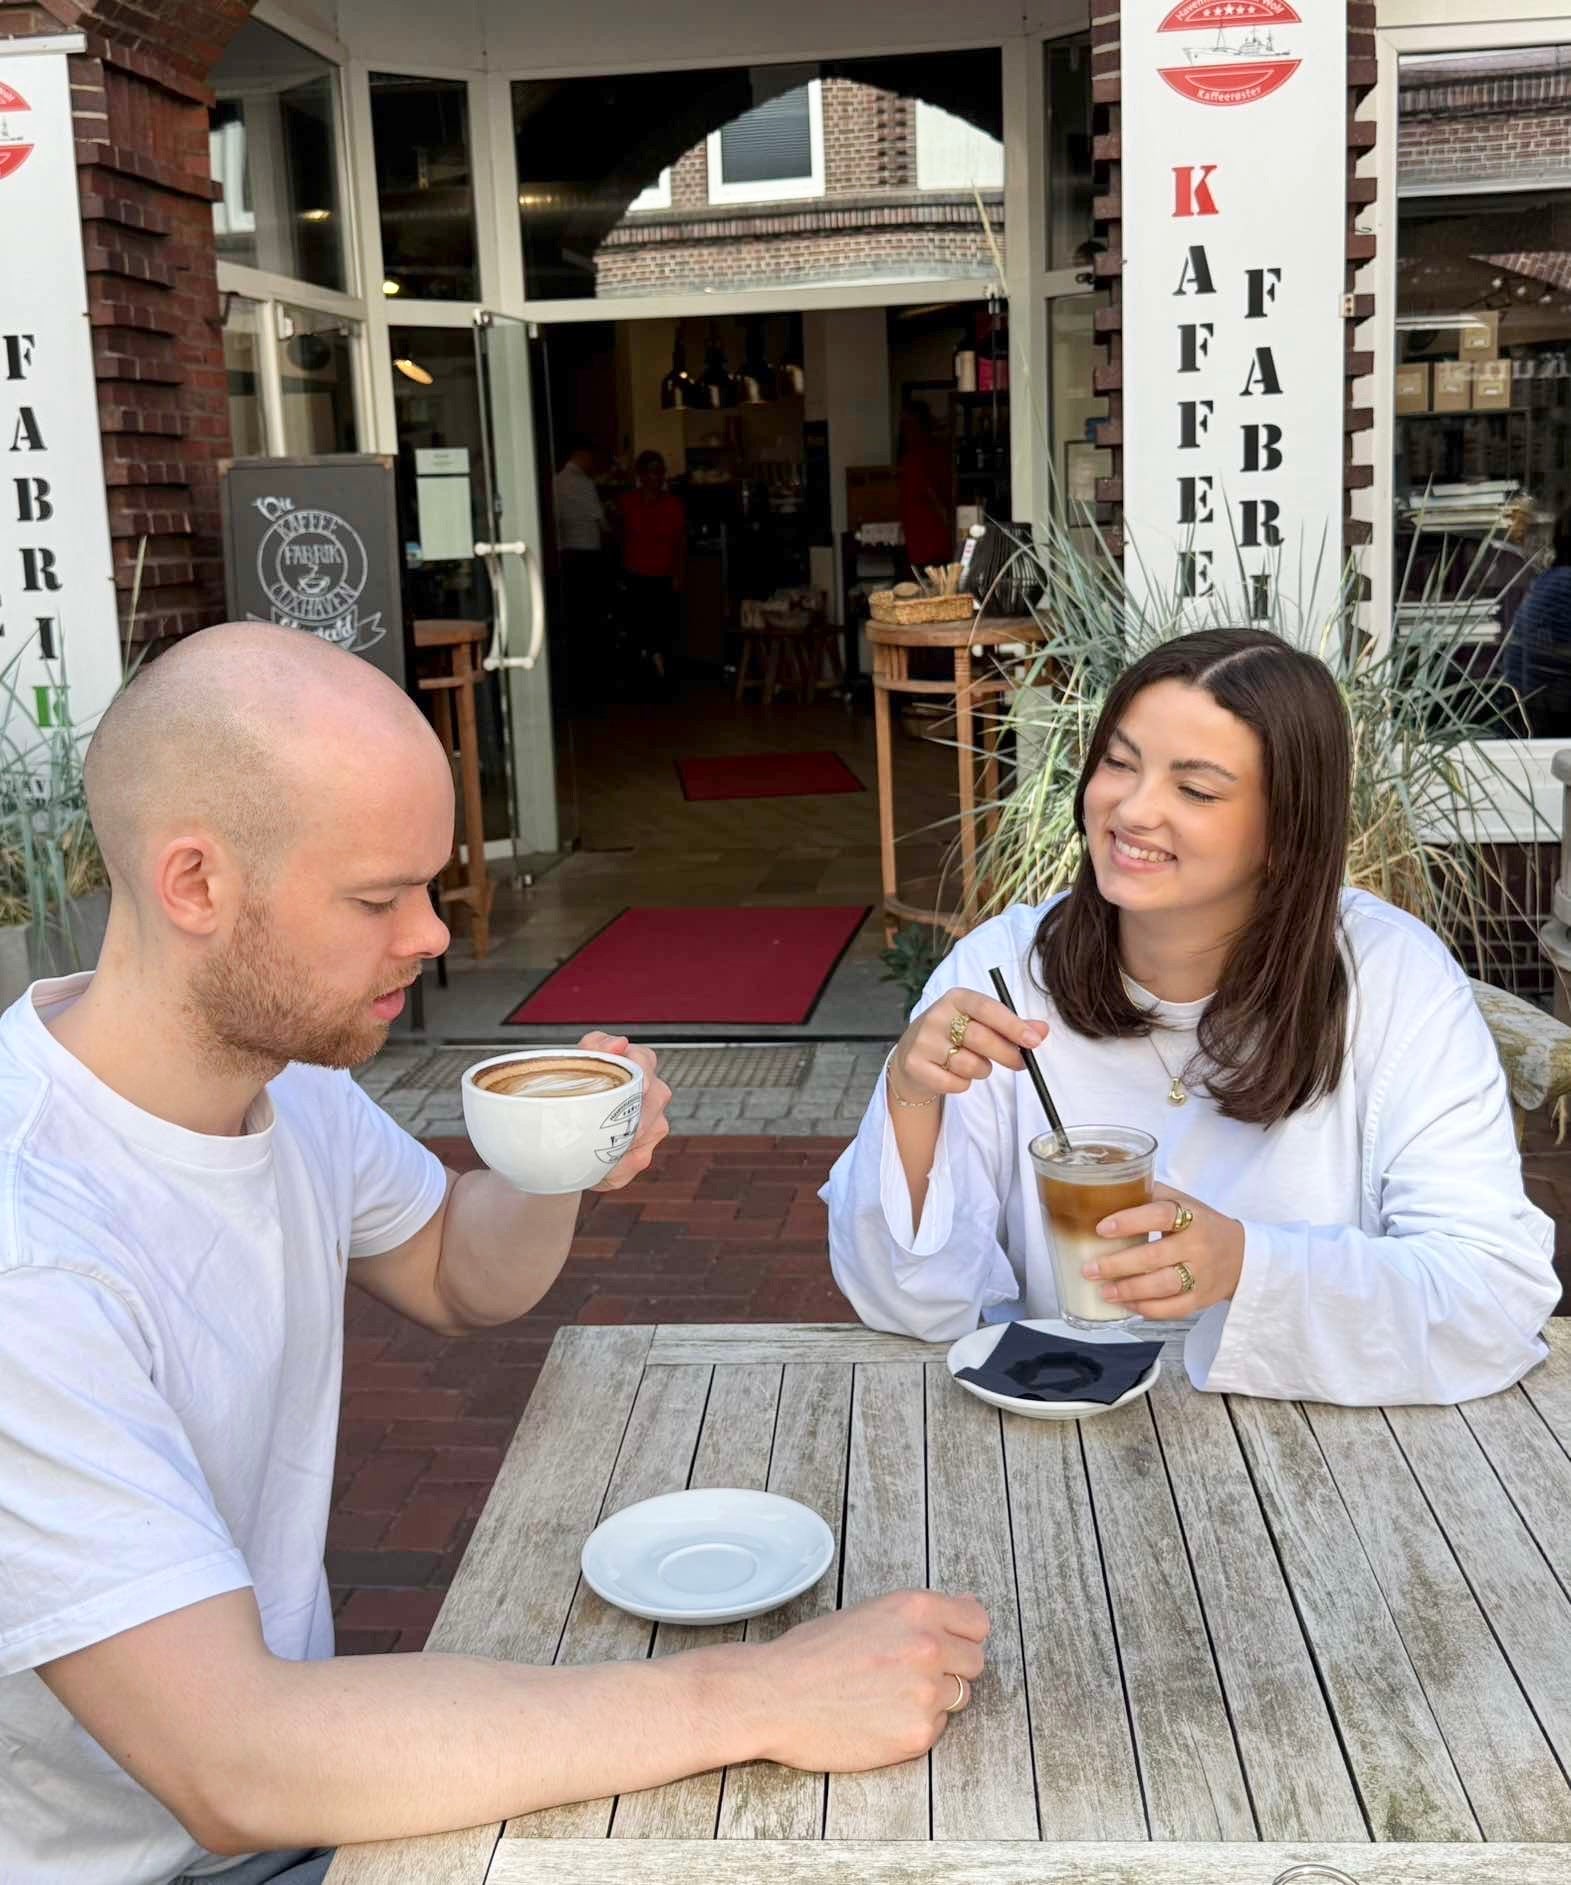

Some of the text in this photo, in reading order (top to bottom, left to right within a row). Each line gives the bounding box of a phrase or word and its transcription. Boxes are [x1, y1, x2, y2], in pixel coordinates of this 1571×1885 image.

[2, 334, 75, 728] FABRIK
[284, 543, 342, 566] FABRIK
[1171, 165, 1219, 598] KAFFEE
[1239, 268, 1285, 620] FABRI
[269, 581, 360, 619] CUXHAVEN
